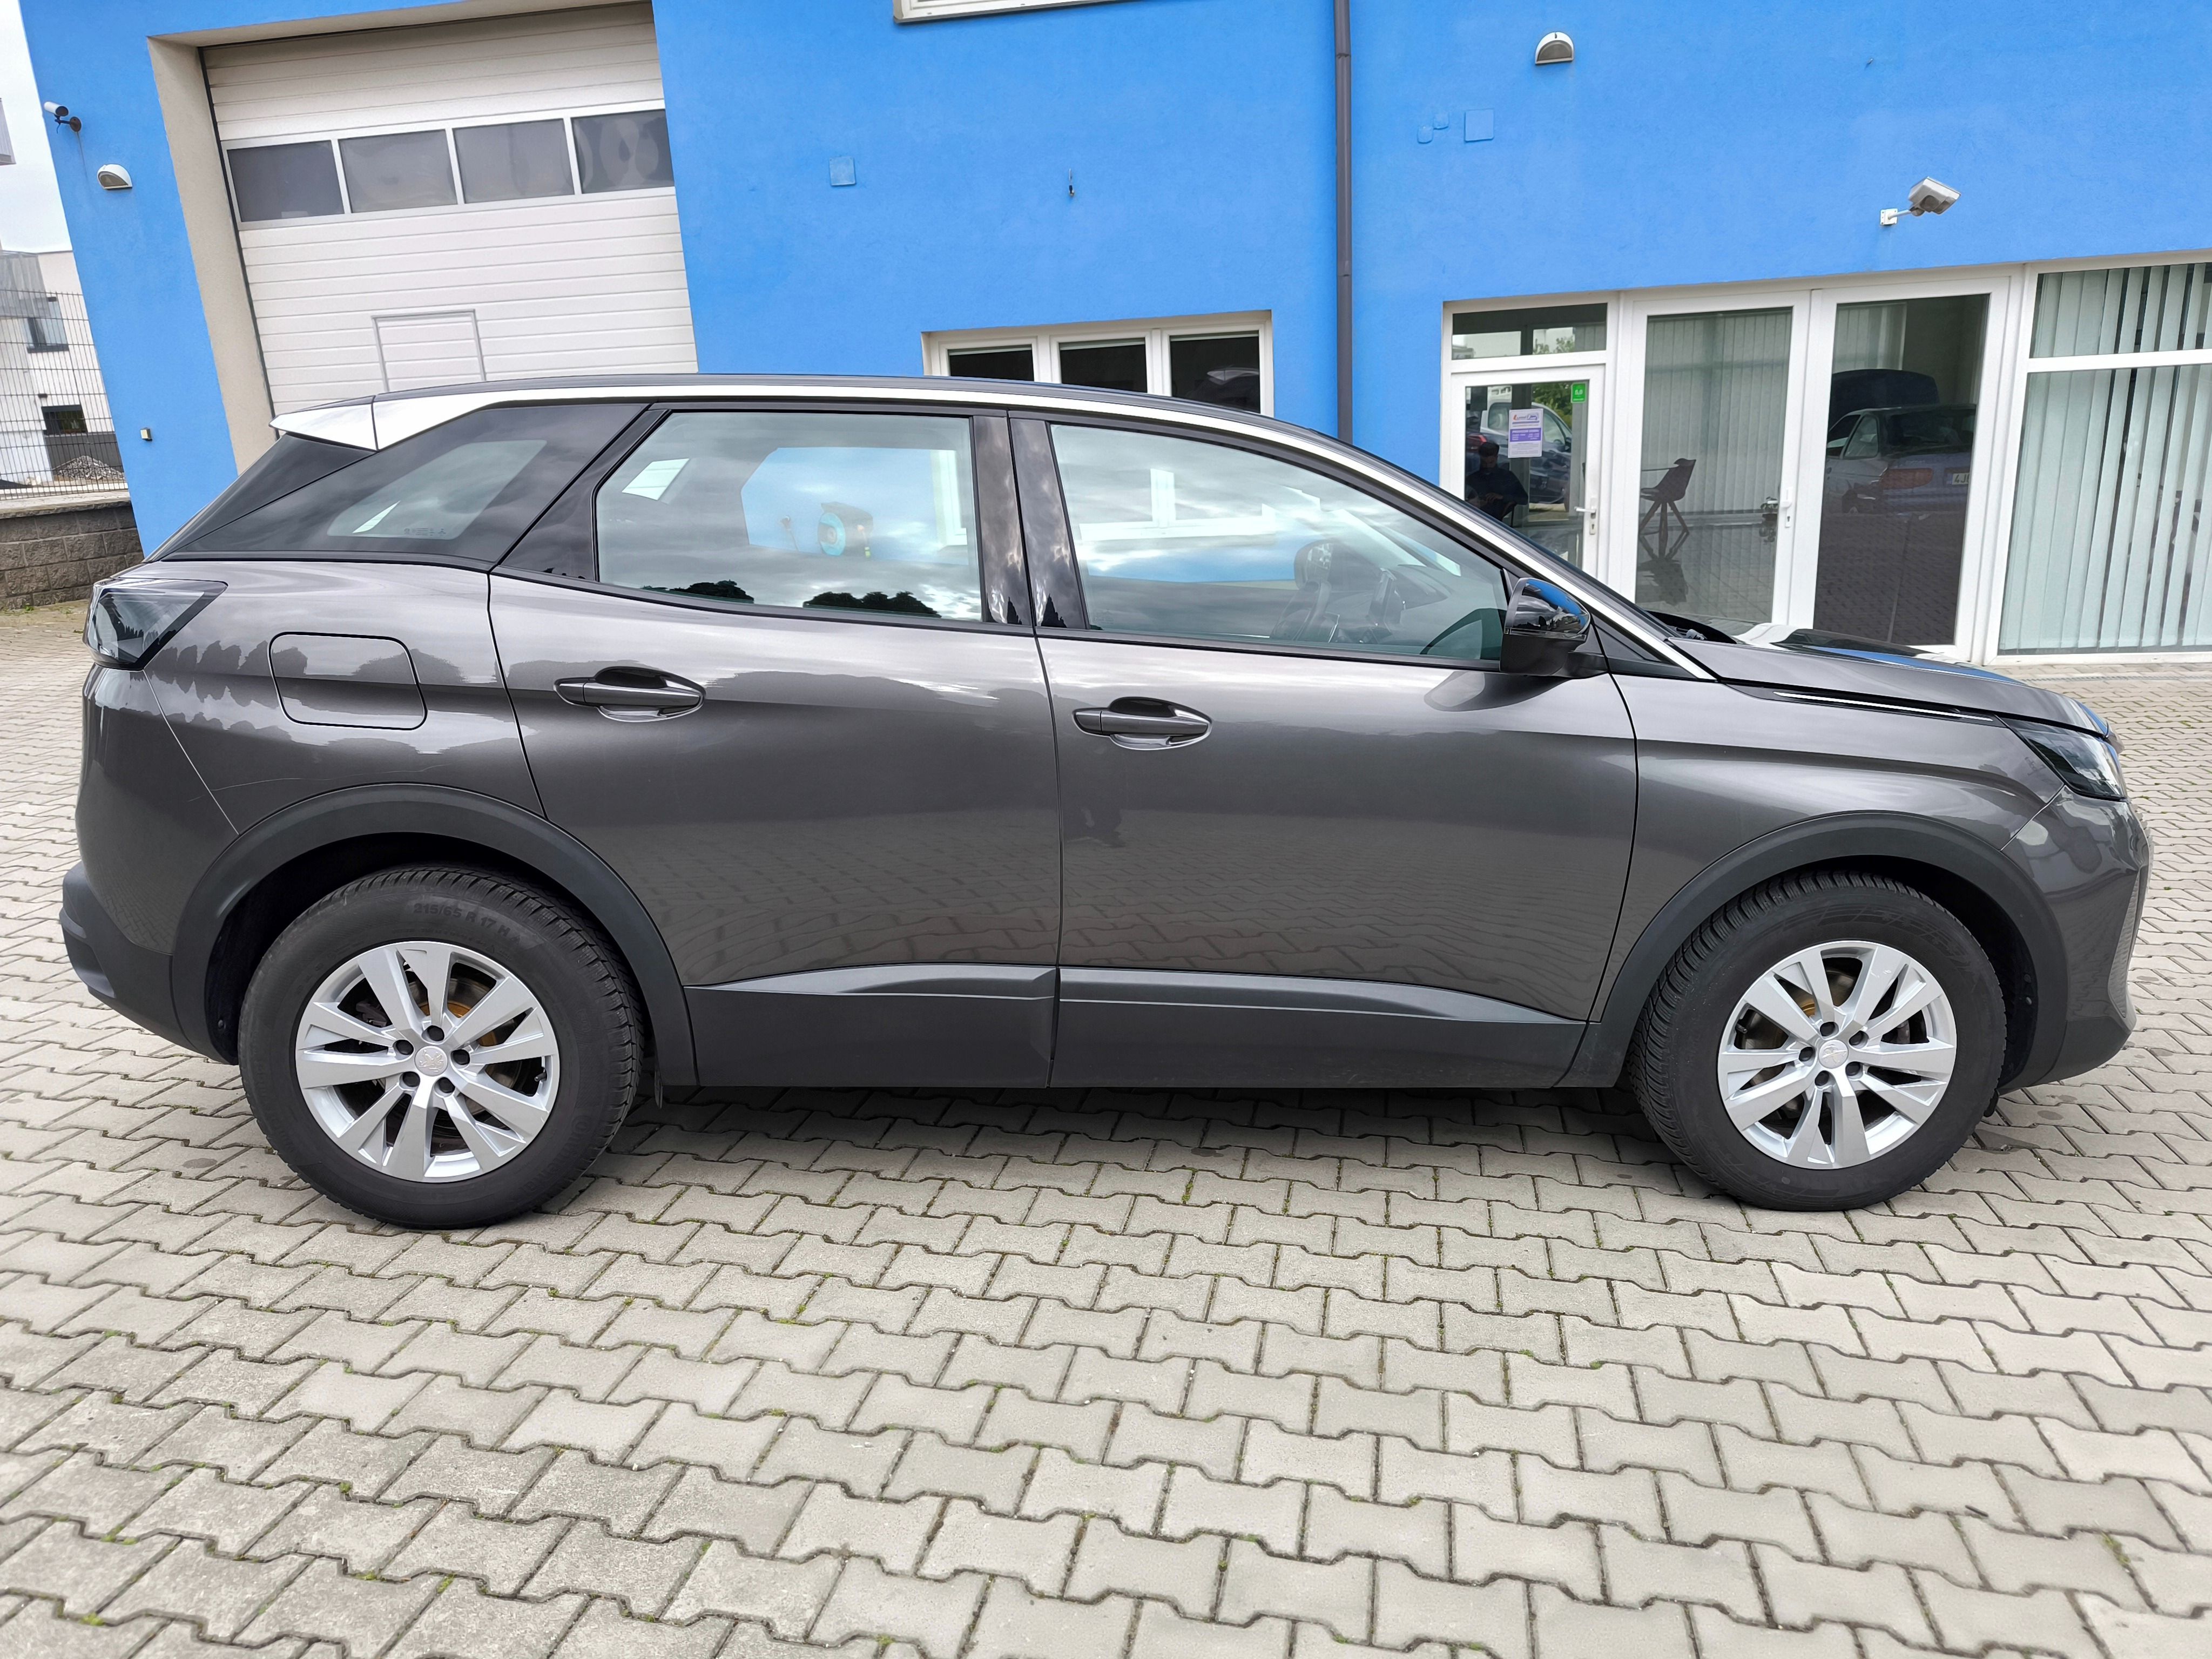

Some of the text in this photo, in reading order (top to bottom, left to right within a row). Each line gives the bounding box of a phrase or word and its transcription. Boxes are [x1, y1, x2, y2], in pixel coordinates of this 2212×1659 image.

[413, 902, 463, 918] 215/65
[466, 911, 477, 923] R
[480, 917, 497, 929] 17
[497, 924, 511, 937] H
